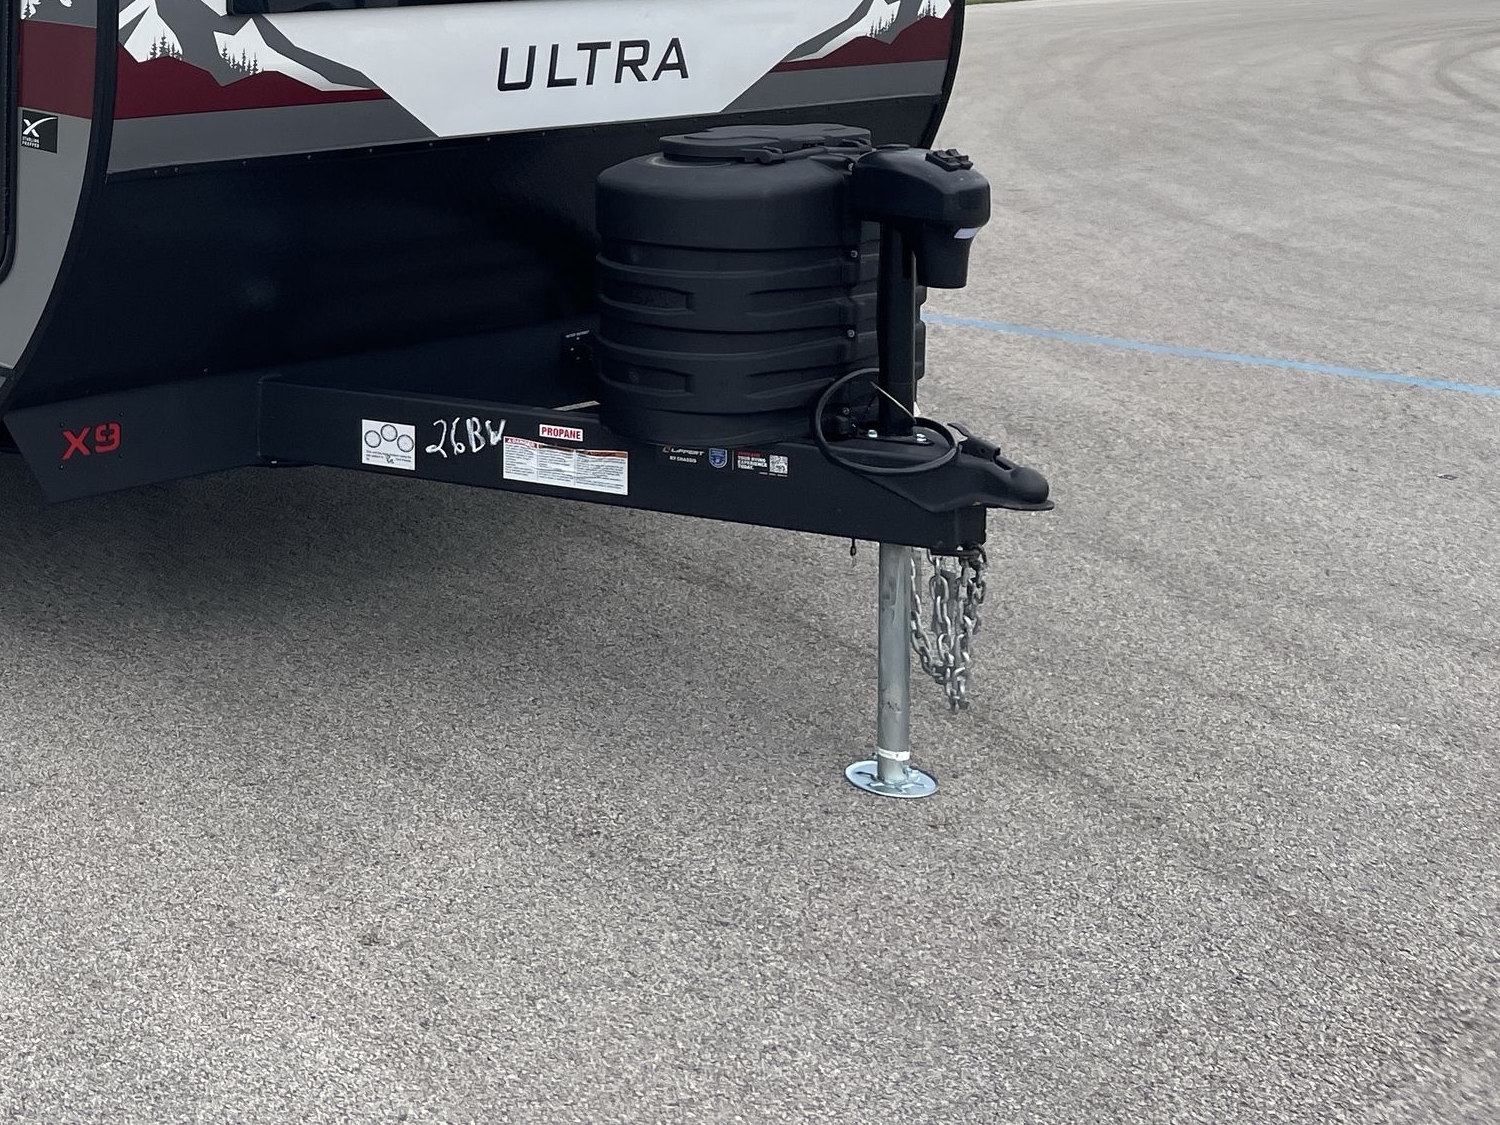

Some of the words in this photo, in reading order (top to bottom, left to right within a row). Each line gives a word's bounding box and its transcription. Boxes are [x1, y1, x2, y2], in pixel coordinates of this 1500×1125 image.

[498, 37, 689, 91] ULTRA
[61, 421, 122, 460] X9
[541, 427, 581, 439] PROPANE
[671, 448, 705, 456] LIPPERT
